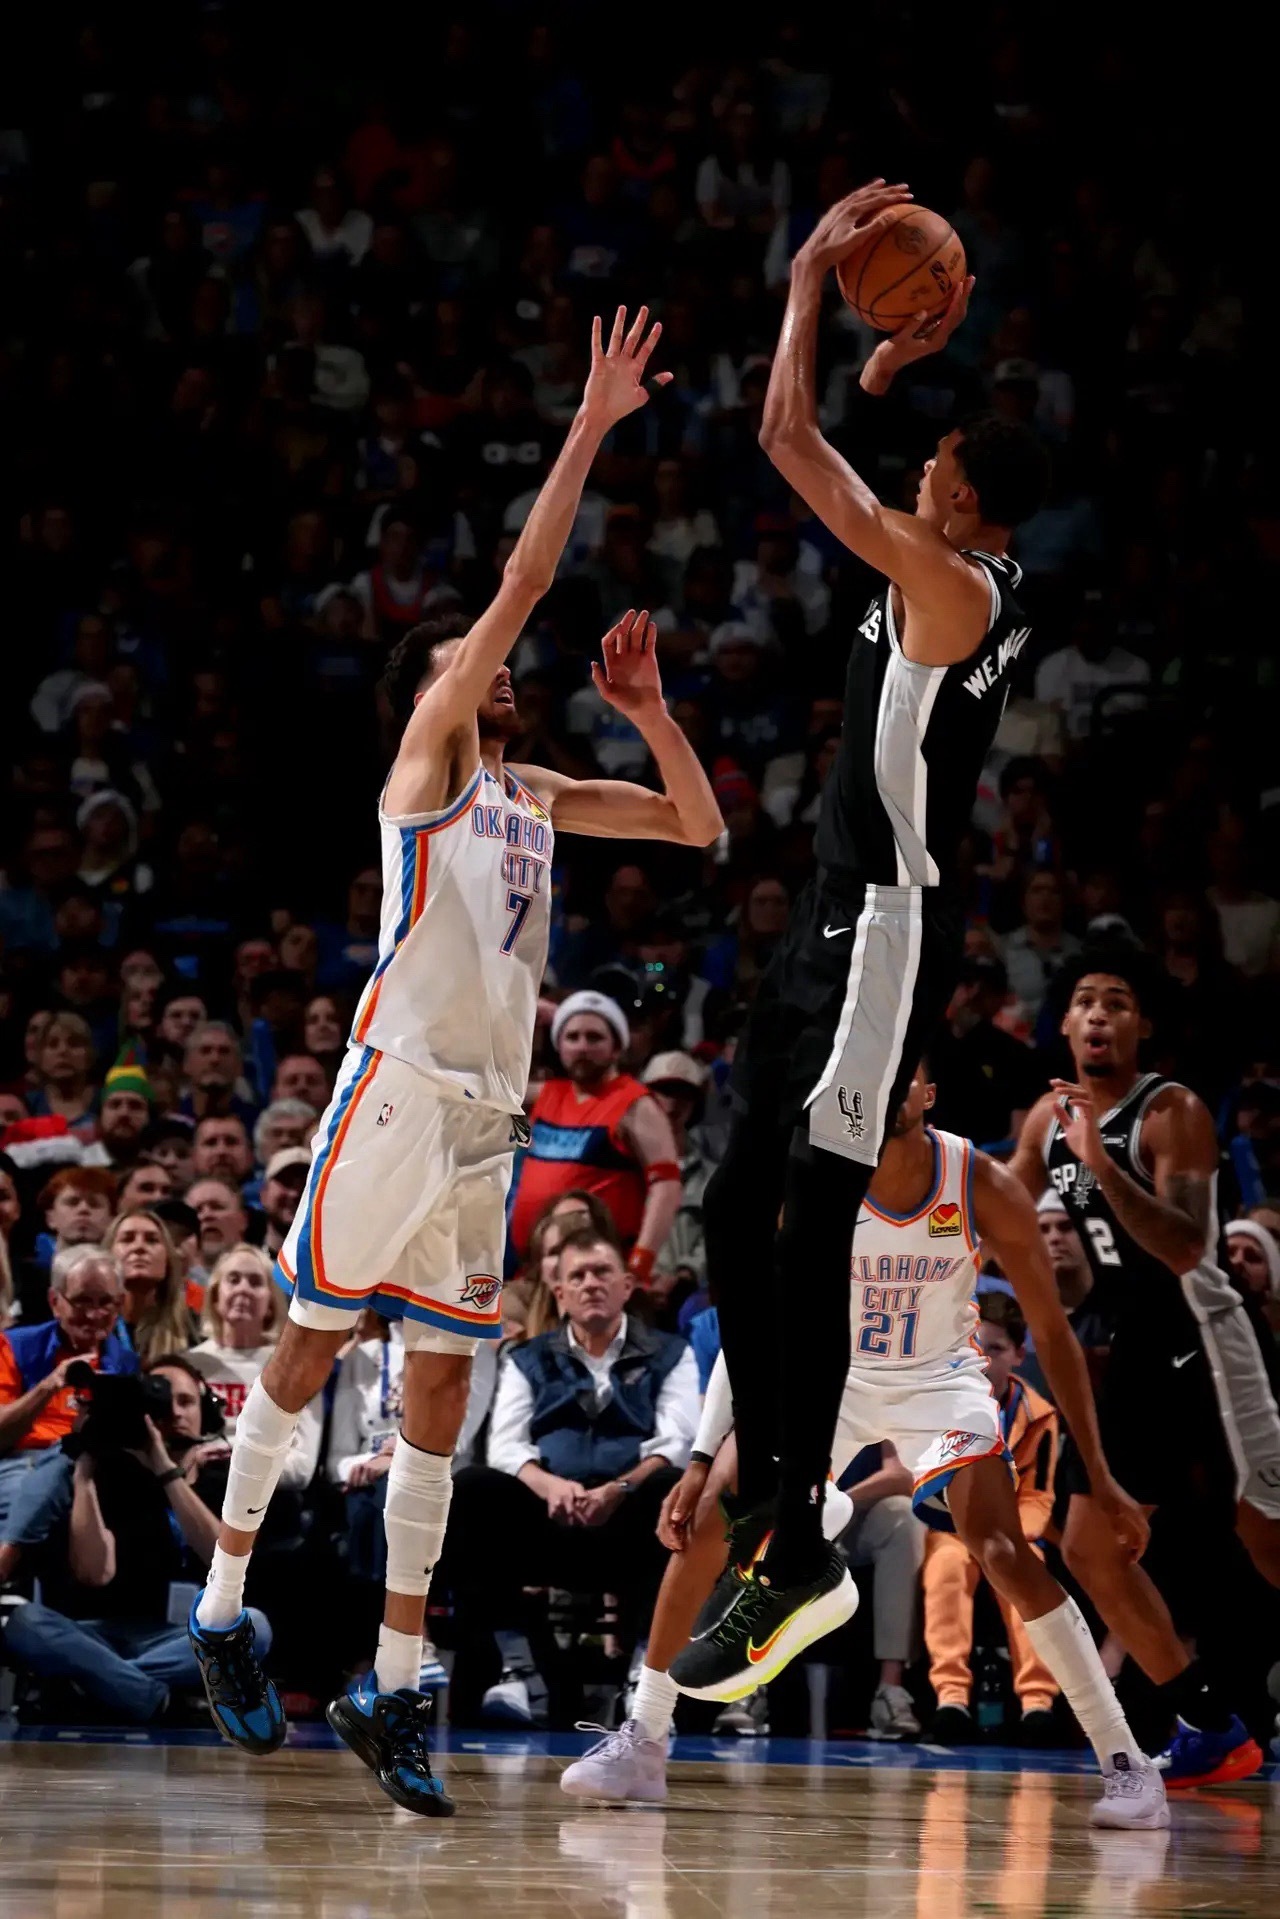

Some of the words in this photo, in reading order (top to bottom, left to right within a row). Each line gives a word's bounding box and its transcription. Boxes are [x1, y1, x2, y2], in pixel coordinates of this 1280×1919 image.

[472, 804, 550, 856] OKAHO
[500, 889, 533, 956] 7
[1085, 1217, 1123, 1266] 2
[863, 1285, 924, 1311] CITY
[857, 1310, 920, 1358] 21
